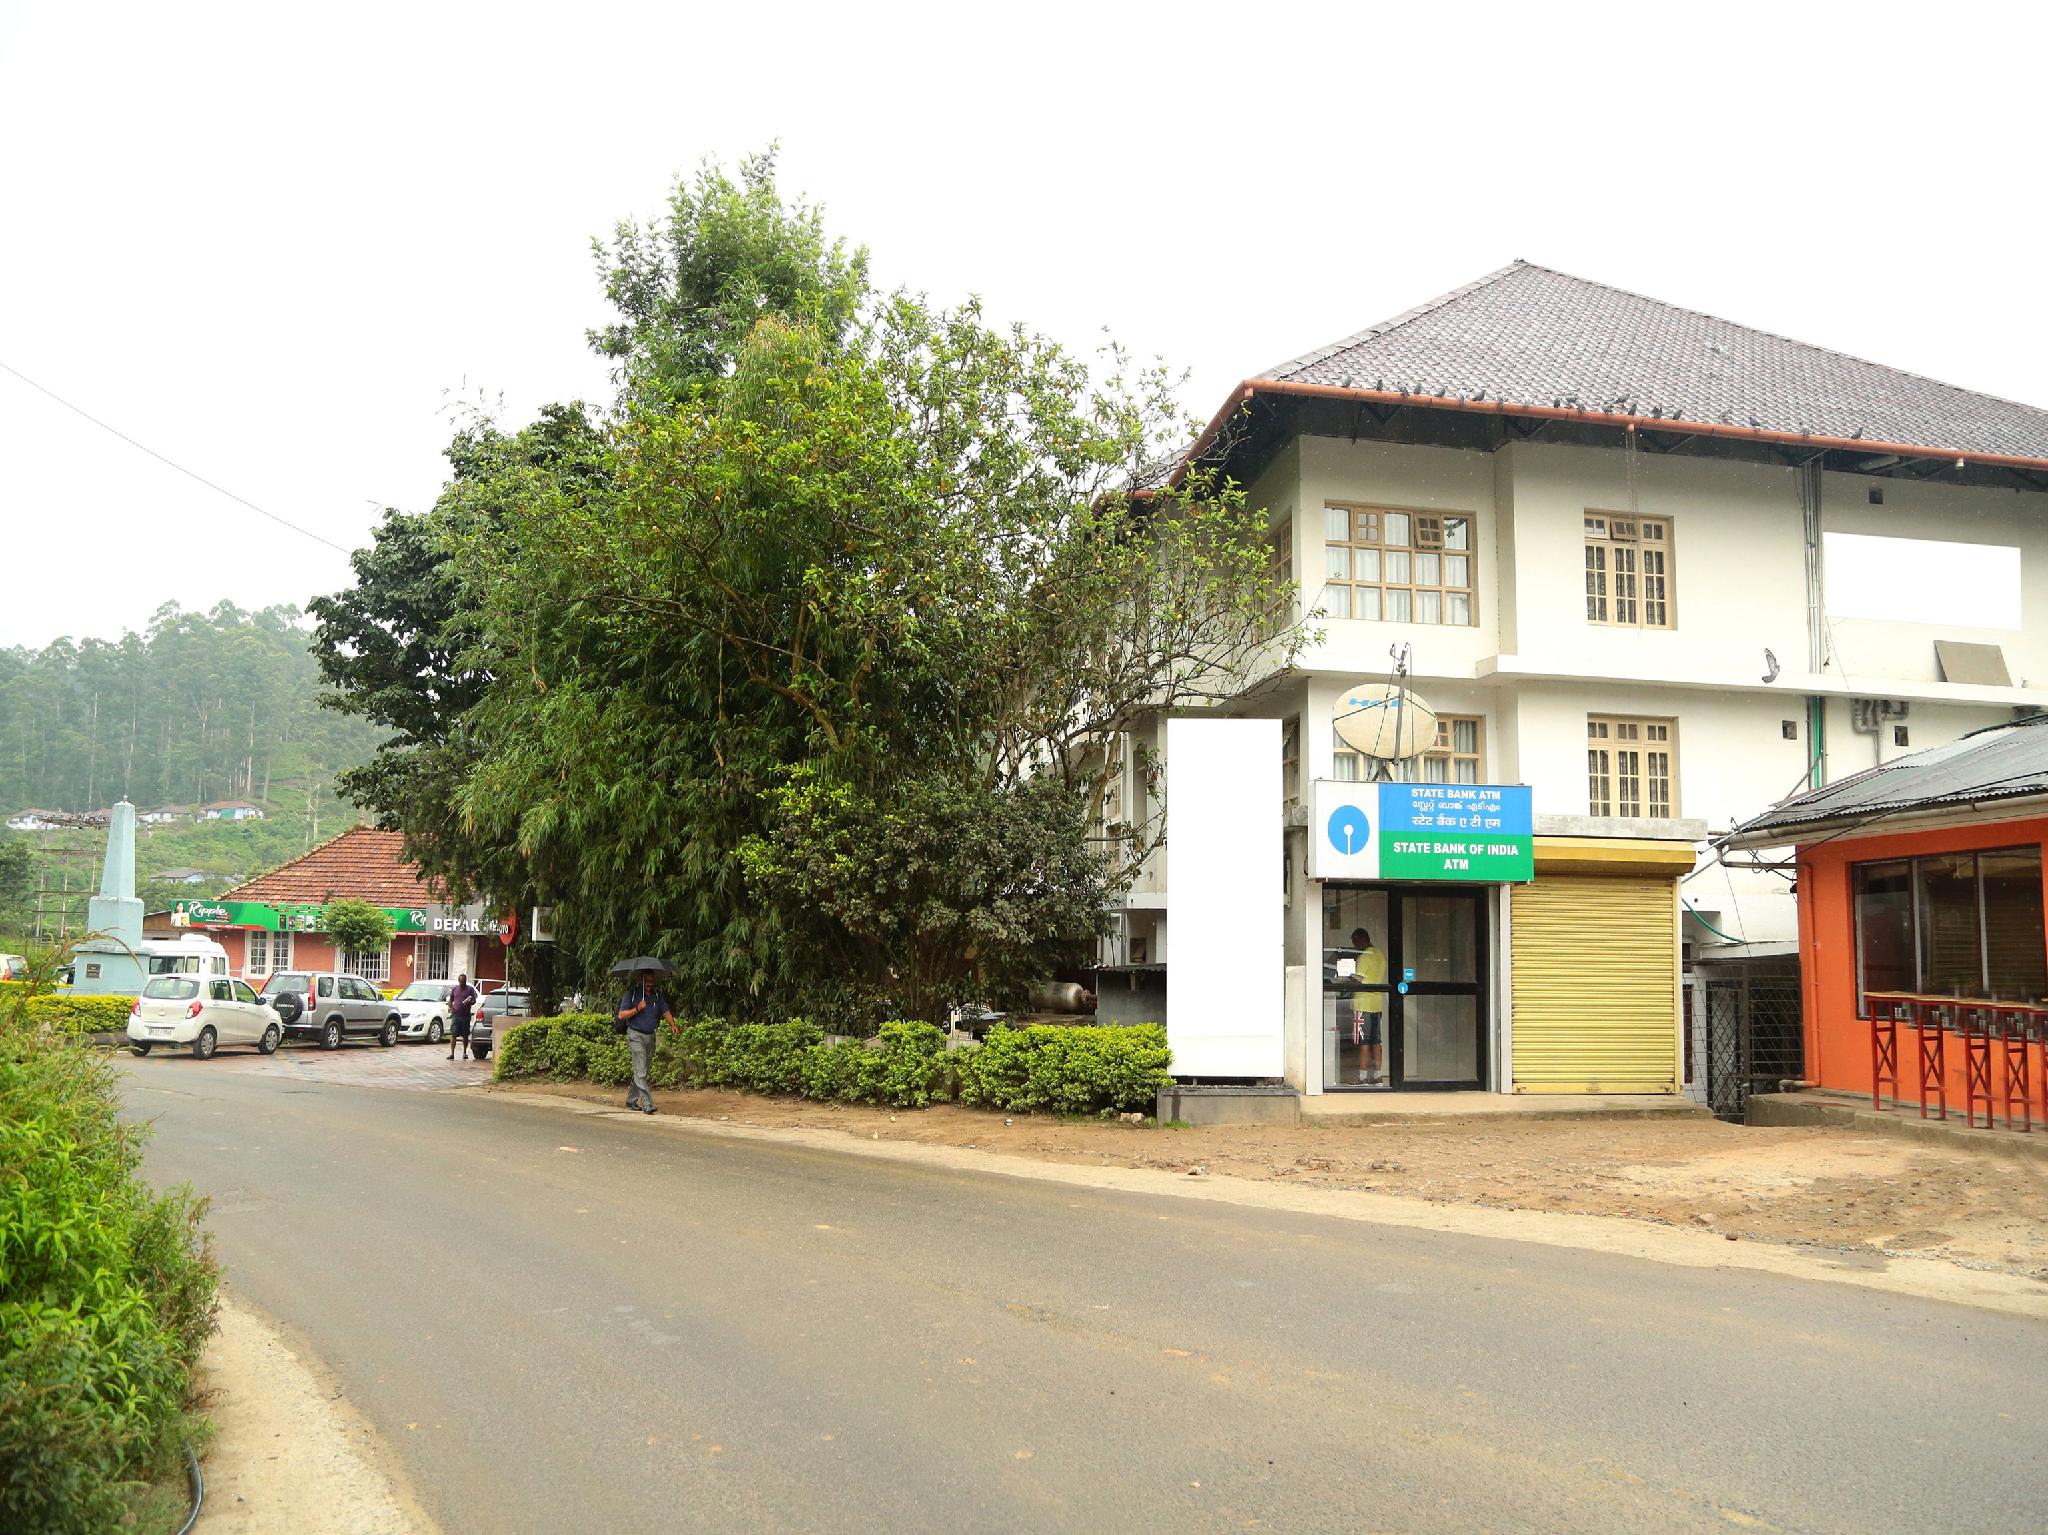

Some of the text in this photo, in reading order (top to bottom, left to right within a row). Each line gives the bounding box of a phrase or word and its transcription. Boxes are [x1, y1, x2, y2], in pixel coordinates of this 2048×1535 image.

[1411, 788, 1501, 800] STATE BANK ATM
[1411, 813, 1501, 828] स्टेट बैंक ए टी एम
[1393, 842, 1519, 856] STATE BANK OF INDIA
[1444, 859, 1469, 870] ATM
[188, 901, 228, 917] Ripple
